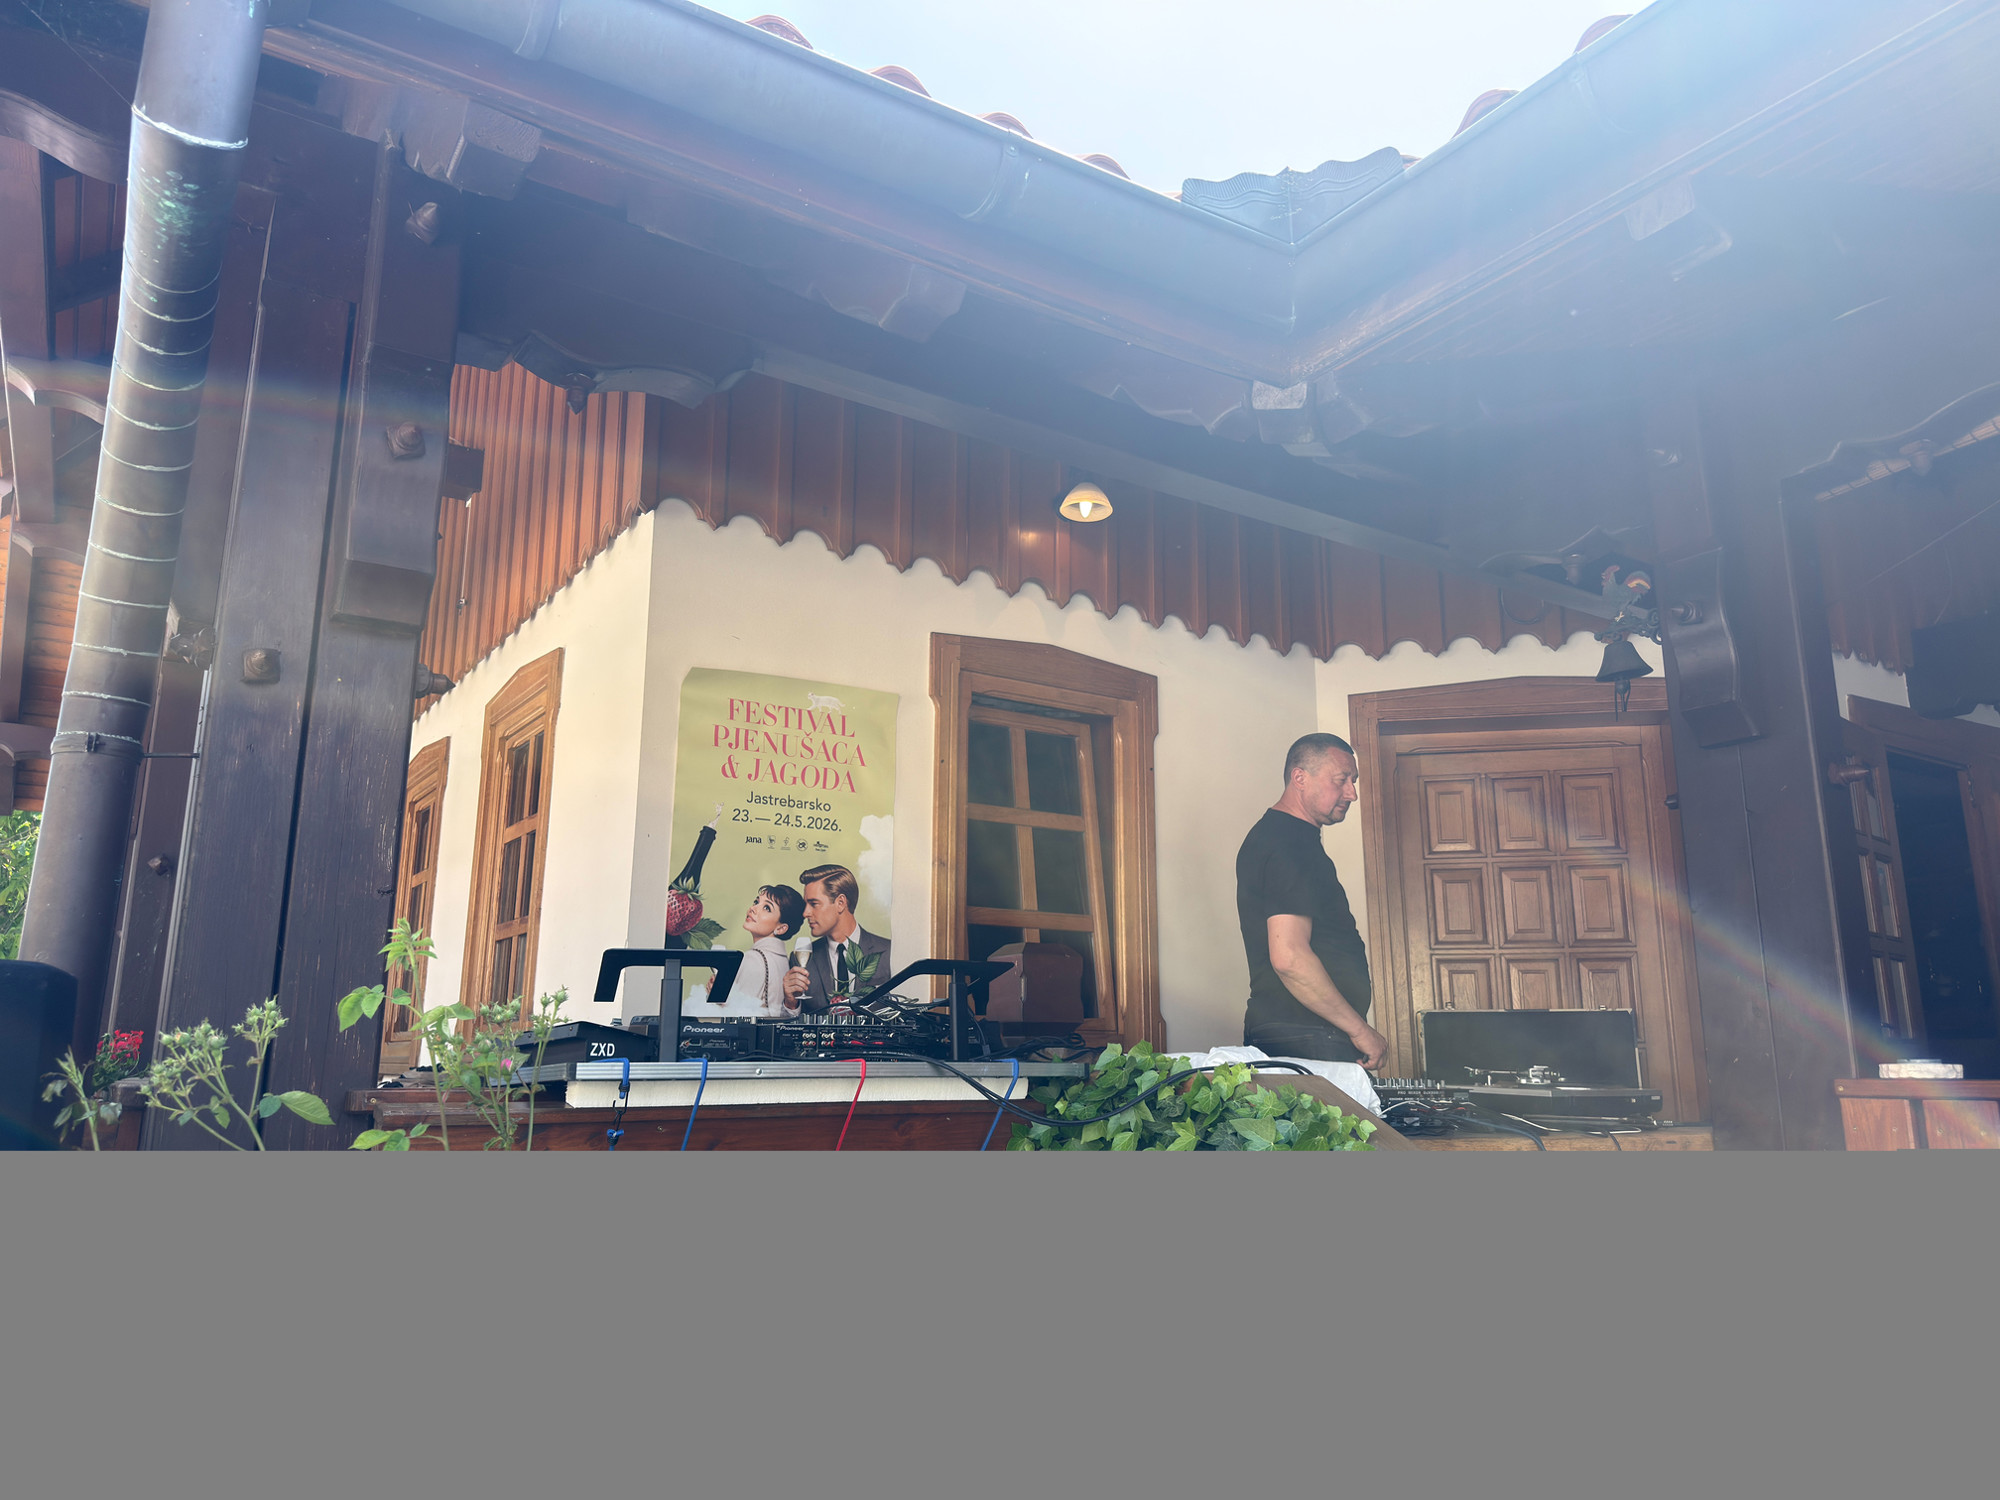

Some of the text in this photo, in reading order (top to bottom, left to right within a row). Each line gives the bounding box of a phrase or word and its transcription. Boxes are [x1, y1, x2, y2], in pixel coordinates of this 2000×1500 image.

[728, 697, 856, 738] FESTIVAL
[712, 724, 867, 768] PJENUŠACA
[720, 754, 857, 793] & JAGODA
[746, 791, 832, 812] Jastrebarsko
[774, 812, 842, 832] 24.5.2026.
[683, 1025, 725, 1033] Pioneer
[589, 1042, 616, 1057] ZXD
